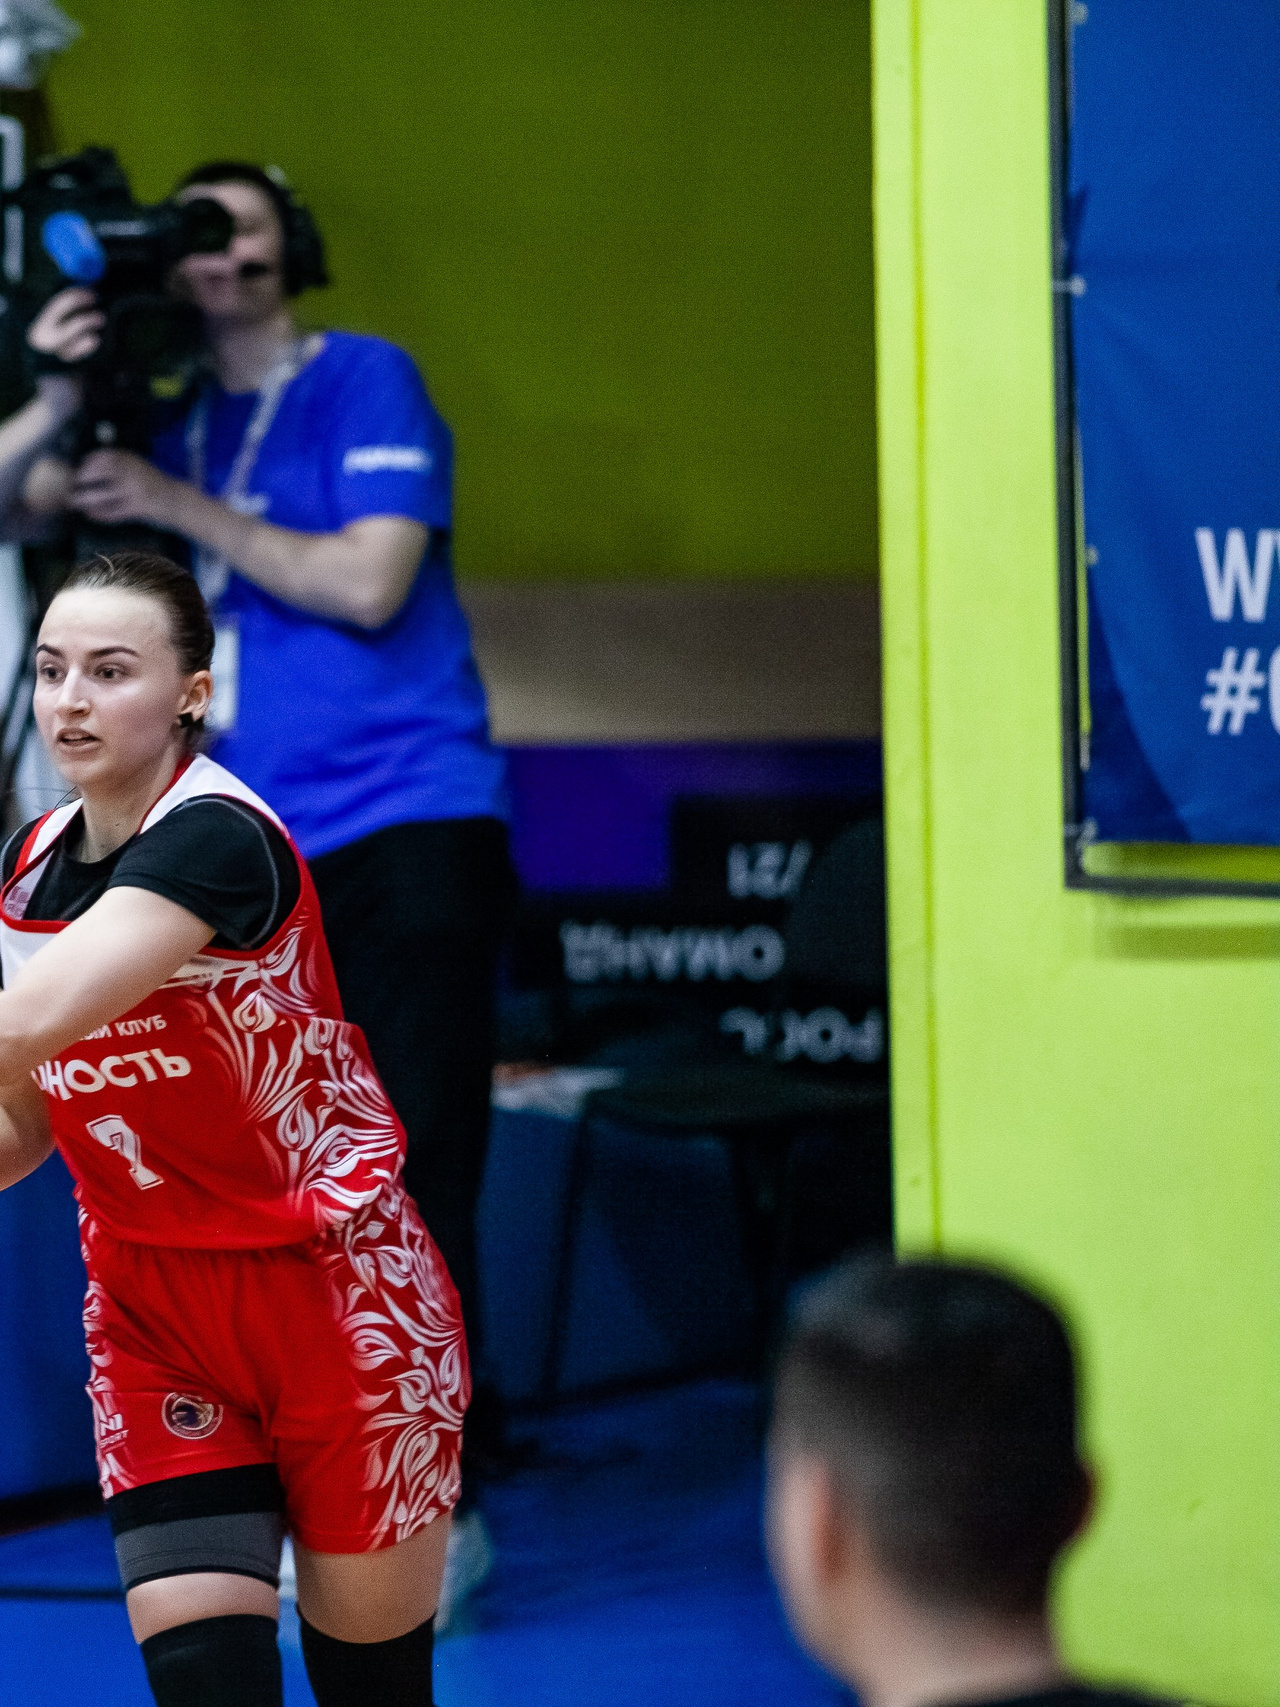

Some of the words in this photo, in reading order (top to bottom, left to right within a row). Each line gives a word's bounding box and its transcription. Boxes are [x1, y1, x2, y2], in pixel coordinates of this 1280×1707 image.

[1195, 526, 1280, 623] W
[114, 1014, 168, 1037] КЛУБ
[85, 1113, 165, 1191] 7
